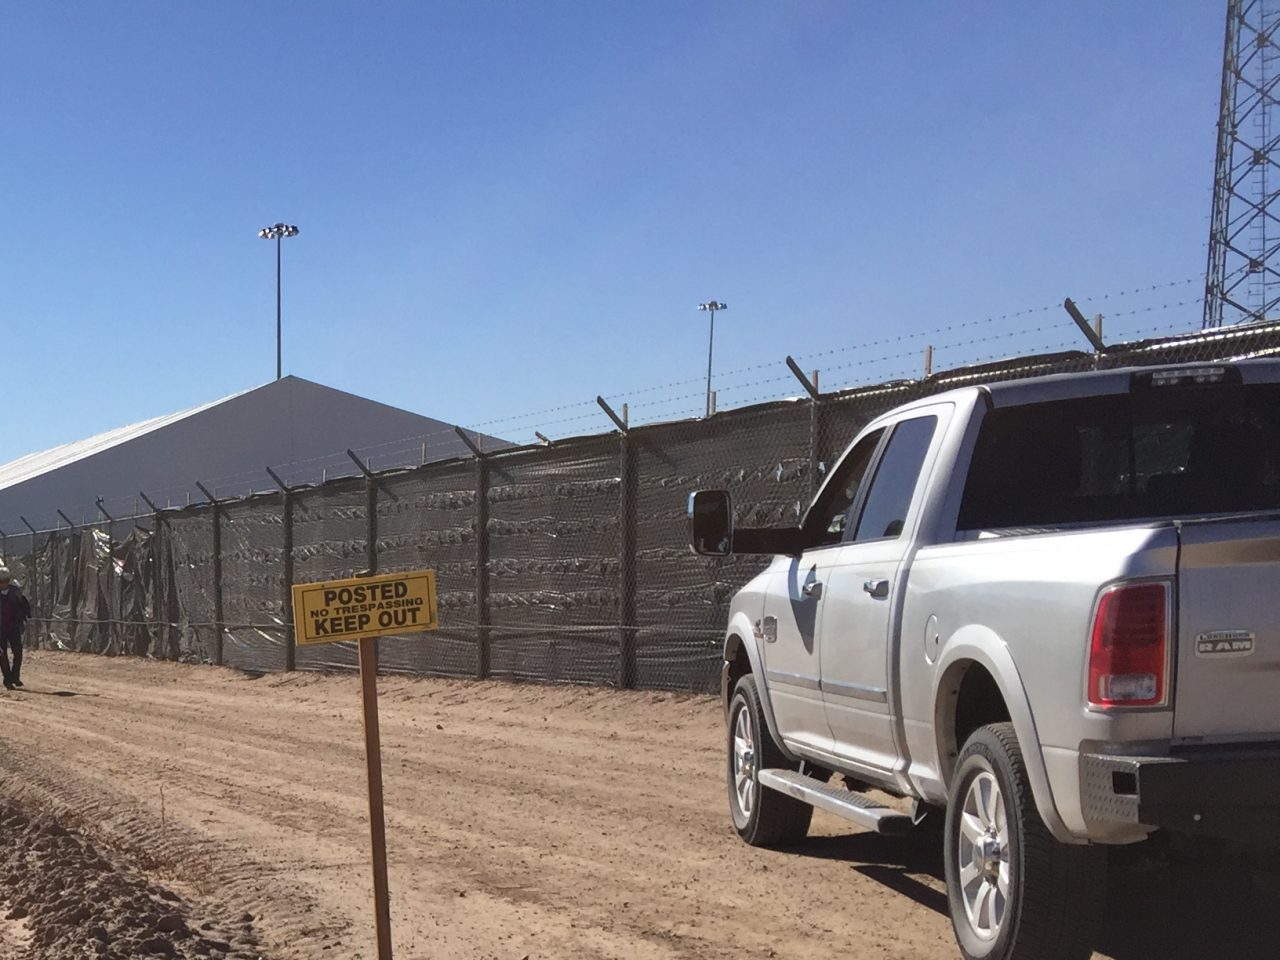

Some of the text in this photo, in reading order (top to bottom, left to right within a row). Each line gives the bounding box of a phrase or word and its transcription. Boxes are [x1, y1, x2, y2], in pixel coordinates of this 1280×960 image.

[324, 582, 408, 607] POSTED
[310, 597, 424, 618] NO TRESPASSING
[315, 607, 420, 636] KEEP OUT
[1199, 641, 1251, 652] RAM
